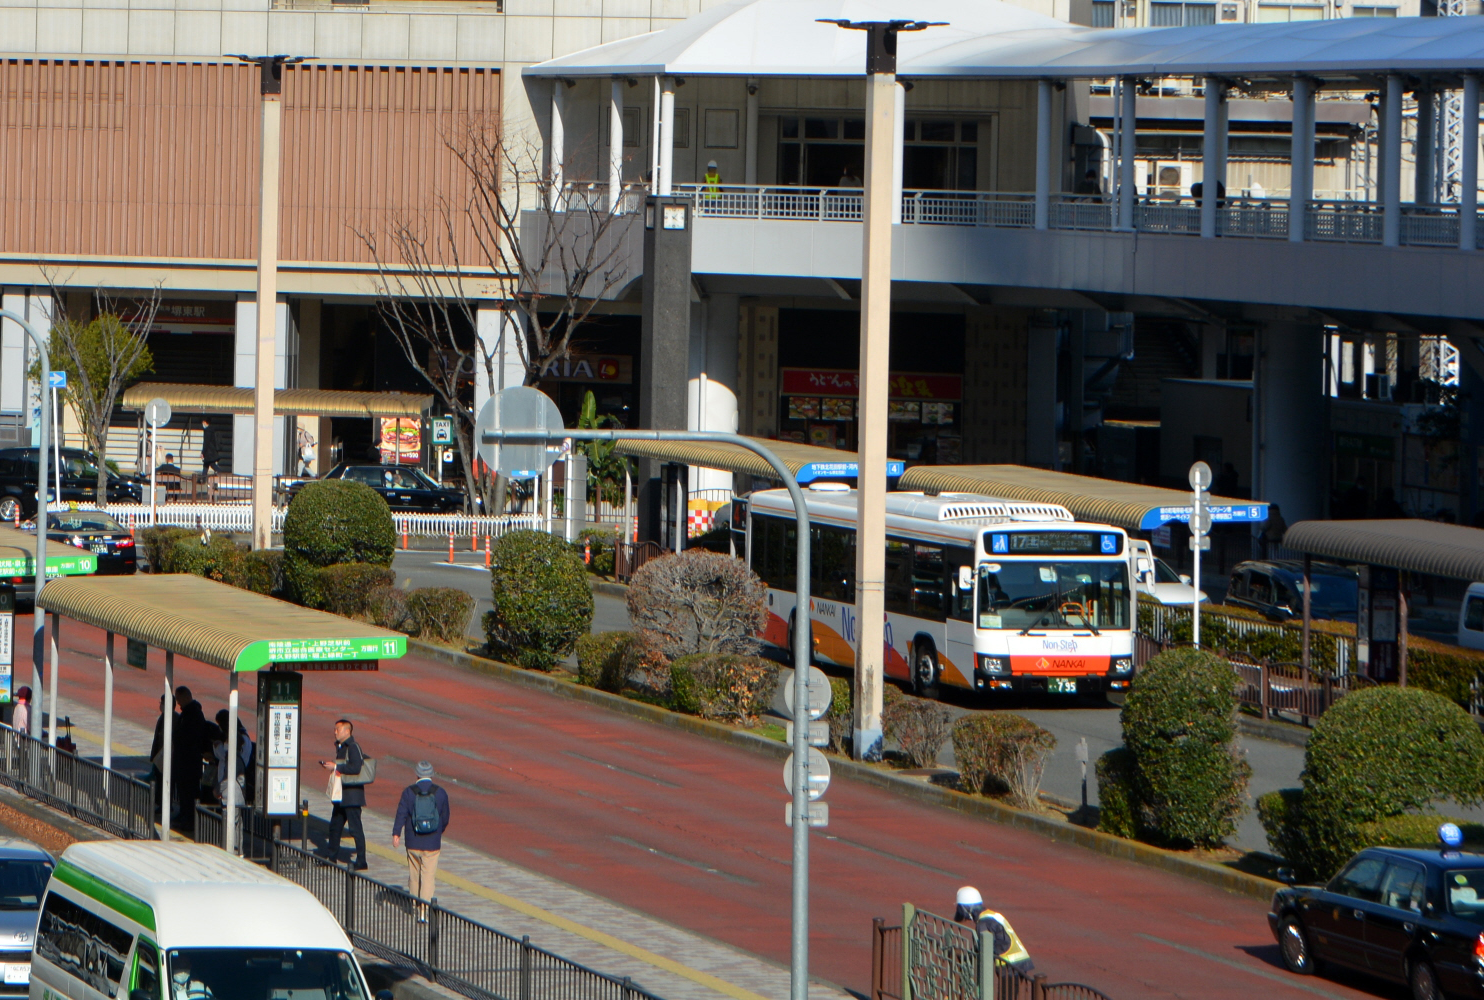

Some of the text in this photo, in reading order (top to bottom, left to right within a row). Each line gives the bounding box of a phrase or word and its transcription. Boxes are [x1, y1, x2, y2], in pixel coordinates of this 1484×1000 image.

[171, 305, 206, 317] 堺東駅
[890, 464, 897, 473] 4
[1251, 508, 1258, 517] 5
[79, 560, 91, 570] 10
[816, 602, 836, 618] NANKAI
[383, 641, 396, 654] 11
[1042, 639, 1078, 652] Non-Step
[1052, 659, 1086, 668] NANKAI
[276, 682, 291, 695] 11
